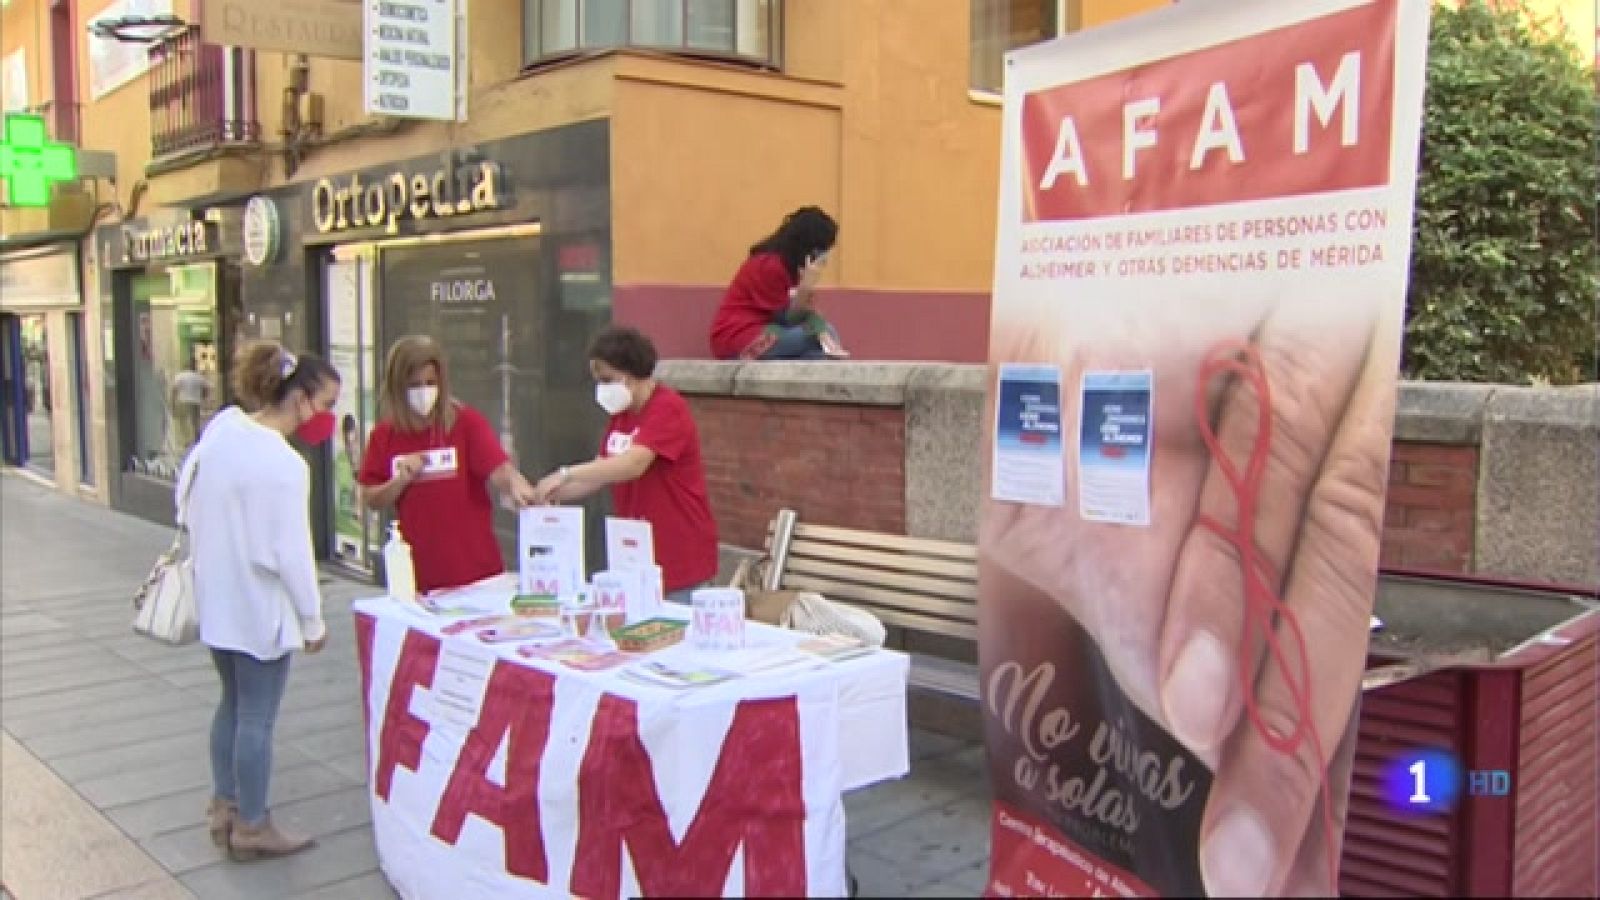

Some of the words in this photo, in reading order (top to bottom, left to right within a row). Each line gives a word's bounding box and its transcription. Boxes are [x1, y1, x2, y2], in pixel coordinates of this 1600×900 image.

[1040, 50, 1361, 190] AFAM
[312, 160, 500, 234] Ortopedia
[1104, 232, 1123, 251] DE
[1126, 224, 1212, 247] FAMILIARES
[1217, 221, 1238, 241] DE
[1243, 213, 1338, 240] PERSONAS
[1344, 208, 1388, 231] CON
[430, 279, 496, 302] FILORGA
[1104, 261, 1111, 277] Y
[1118, 258, 1166, 277] OTRAS
[1172, 251, 1268, 274] DEMENCIAS
[1277, 249, 1301, 269] DE
[1310, 243, 1384, 268] MÉRIDA
[988, 660, 1081, 761] No
[1089, 717, 1195, 809] vivas
[1014, 754, 1039, 790] a
[1045, 765, 1141, 834] solas
